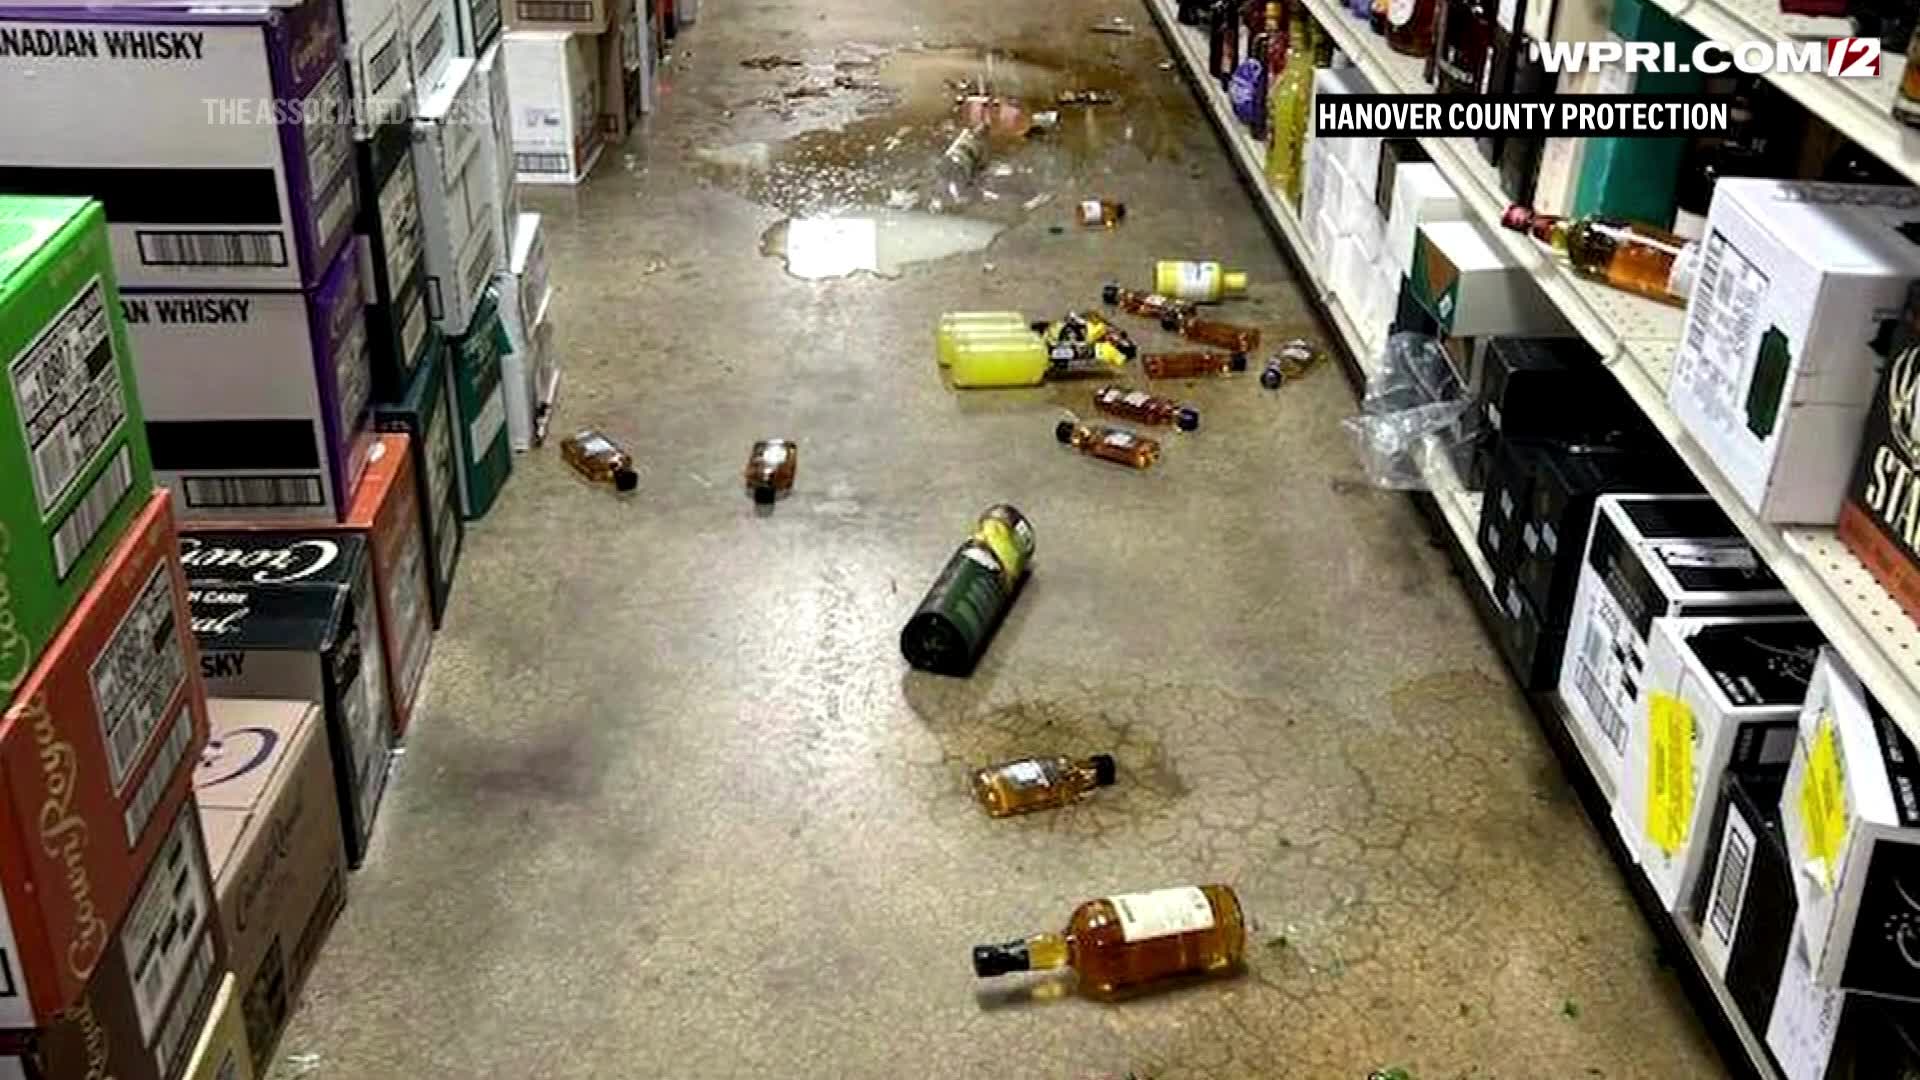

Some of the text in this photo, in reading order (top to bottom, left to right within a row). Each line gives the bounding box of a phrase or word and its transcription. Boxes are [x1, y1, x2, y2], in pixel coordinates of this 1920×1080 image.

[103, 30, 204, 59] WHISKY
[154, 299, 249, 324] WHISKY
[200, 652, 245, 678] SKY
[21, 698, 108, 980] Crown Royal
